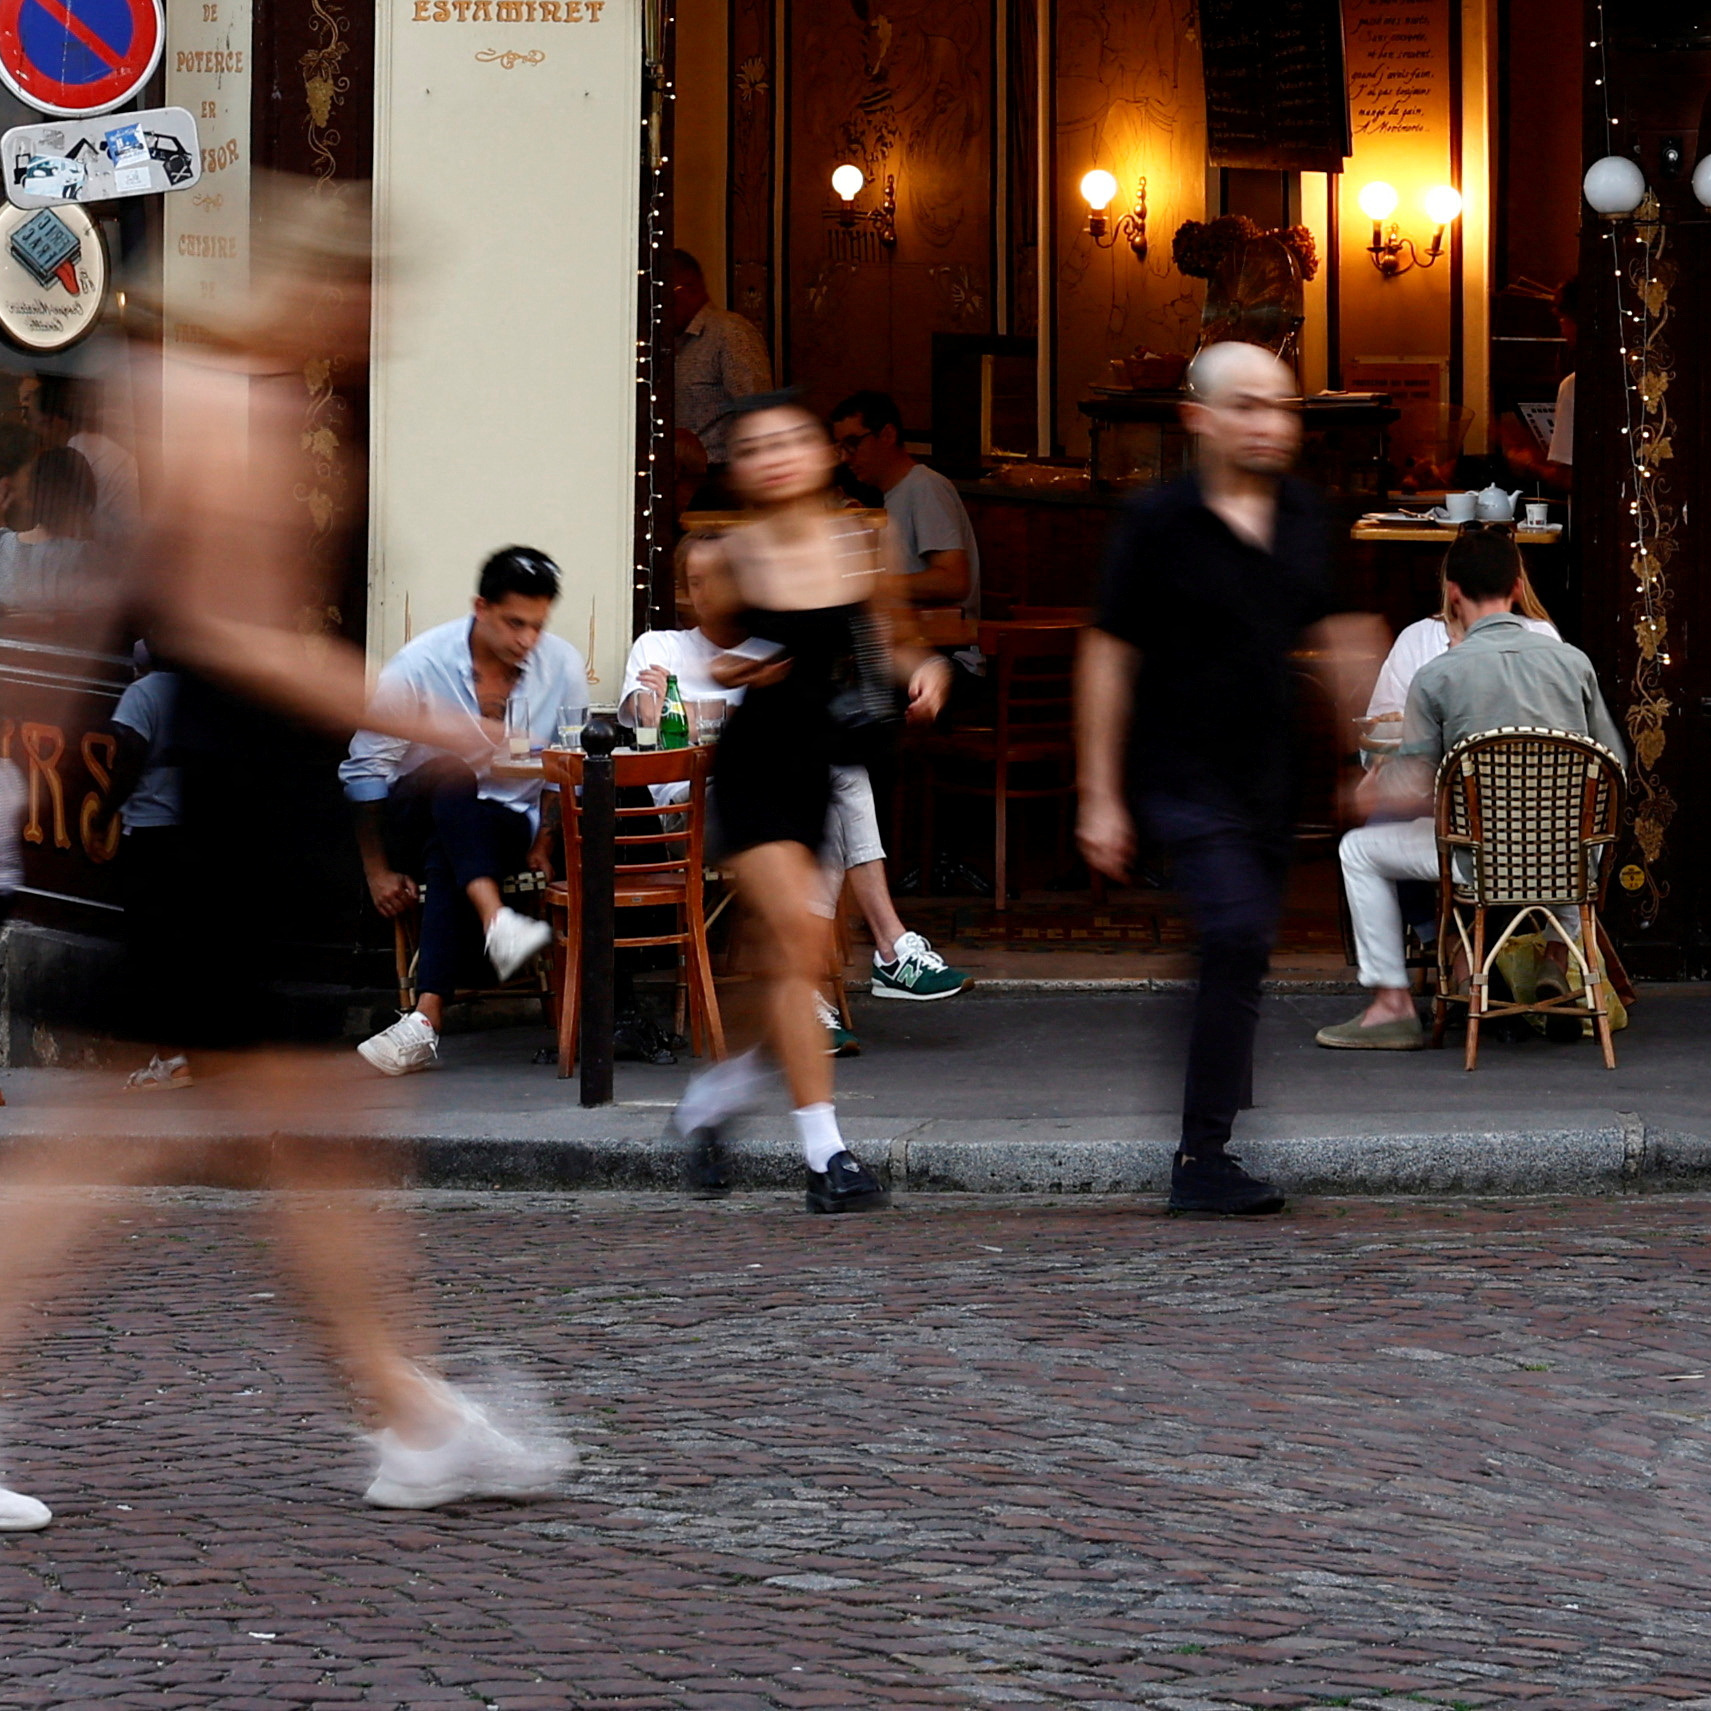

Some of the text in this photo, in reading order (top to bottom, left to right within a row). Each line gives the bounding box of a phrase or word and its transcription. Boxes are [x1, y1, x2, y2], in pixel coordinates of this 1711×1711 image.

[202, 4, 219, 23] DE
[411, 0, 606, 24] ESTAMINET
[201, 137, 240, 174] ISON
